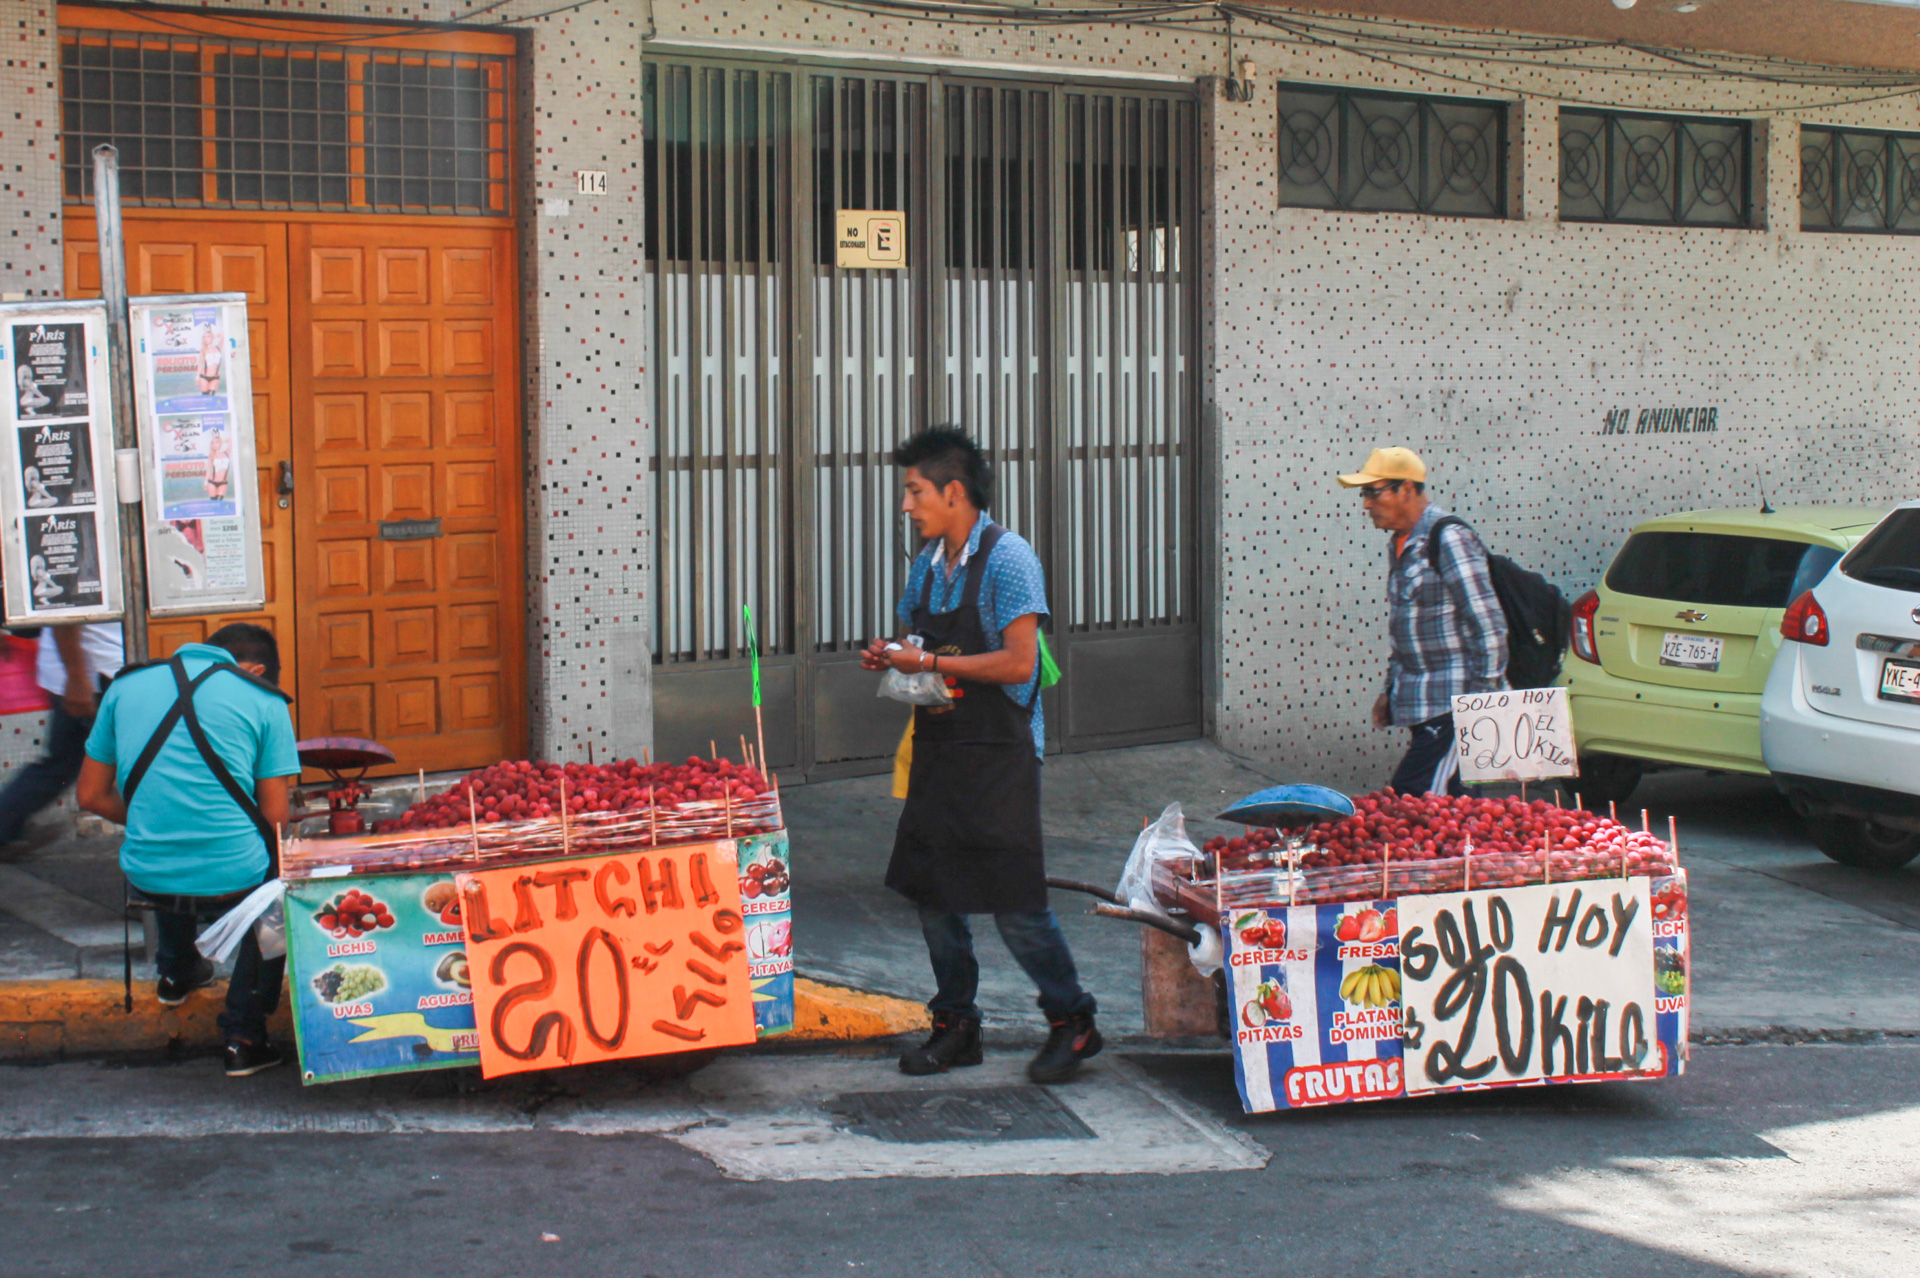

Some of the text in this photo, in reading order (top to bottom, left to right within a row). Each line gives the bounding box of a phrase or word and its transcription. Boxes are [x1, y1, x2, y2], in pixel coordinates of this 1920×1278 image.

[580, 173, 606, 192] 114
[847, 228, 859, 237] NO
[1602, 407, 1718, 435] NO ANUNCIAR
[1662, 641, 1719, 661] XZE-765-A
[1456, 690, 1556, 713] SOLO HOY
[1535, 714, 1556, 733] EL
[464, 852, 720, 944] LITCHI
[1400, 887, 1640, 982] SOLO HOY
[1652, 921, 1684, 936] ICH
[328, 940, 376, 957] LICHIS
[1230, 948, 1308, 967] CEREZAS
[488, 926, 630, 1063] 20
[334, 1003, 373, 1018] UVAS
[1237, 1025, 1303, 1044] PITAYAS
[1288, 1061, 1400, 1101] FRUTAS
